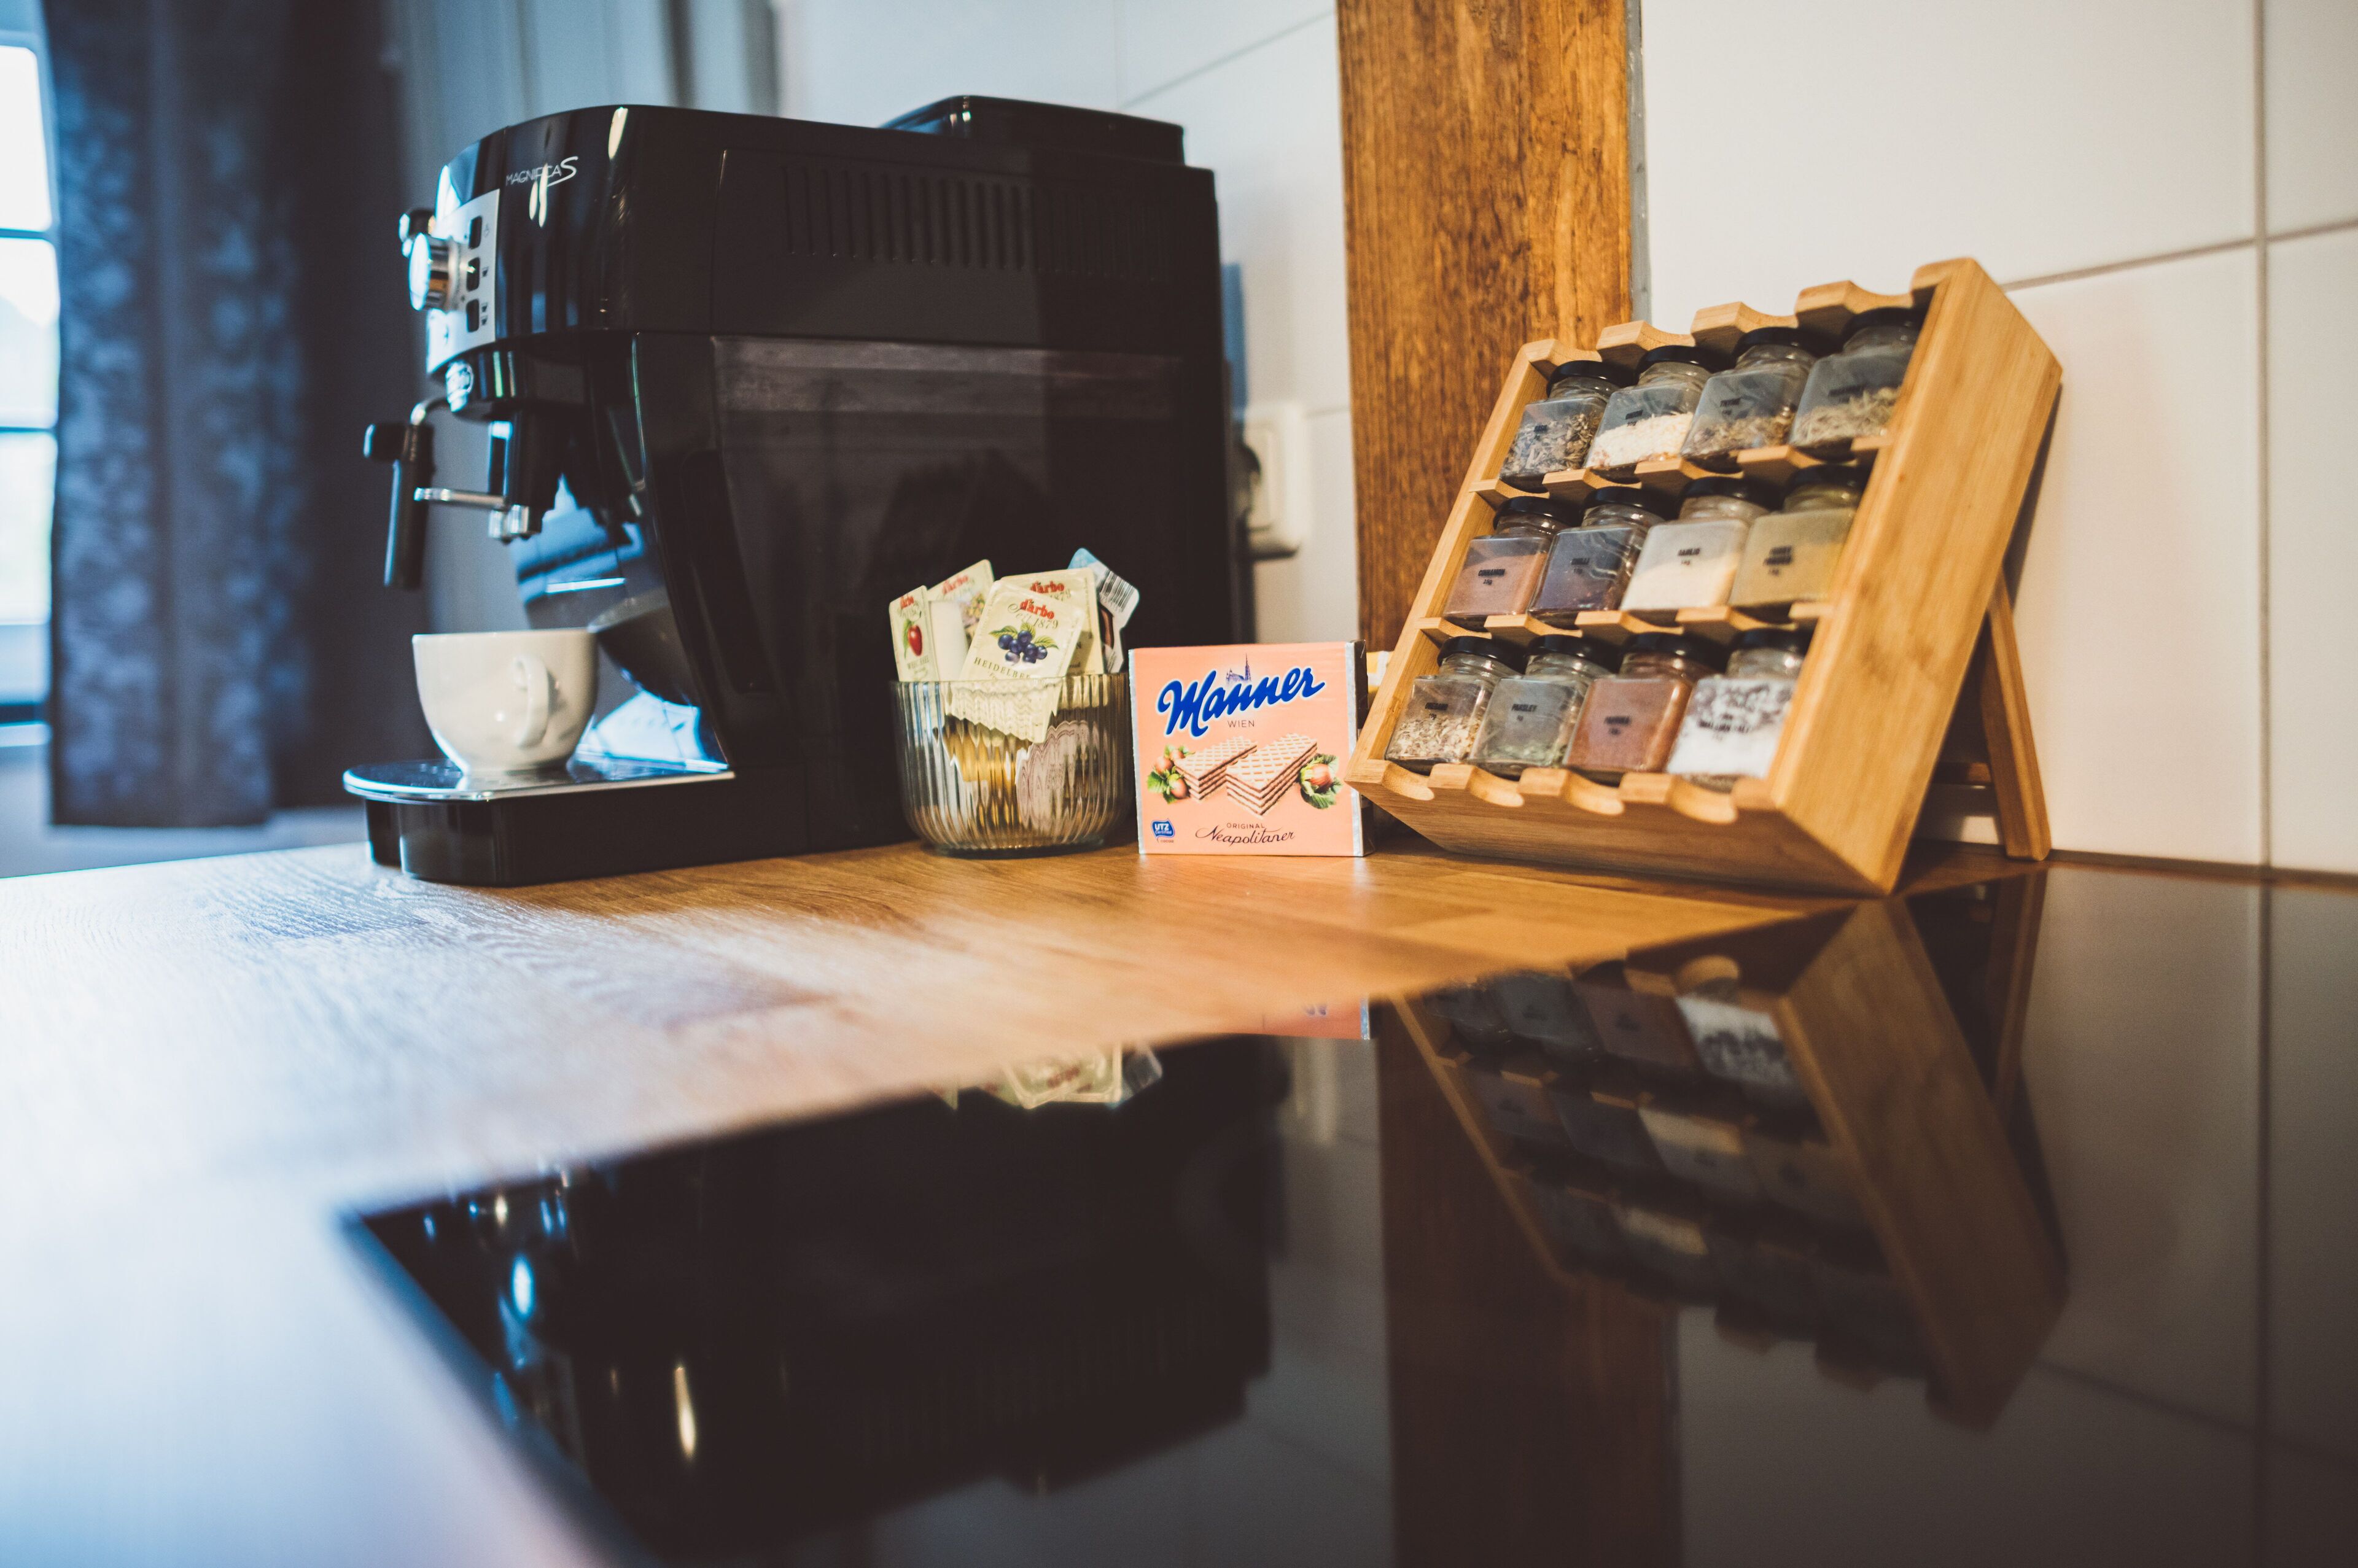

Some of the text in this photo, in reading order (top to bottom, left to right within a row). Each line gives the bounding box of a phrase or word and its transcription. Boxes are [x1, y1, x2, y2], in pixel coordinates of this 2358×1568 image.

[505, 165, 561, 187] MAGNIFCA
[1033, 618, 1059, 629] 1879
[1158, 667, 1326, 737] Manner
[1195, 825, 1296, 847] Neapolitaner
